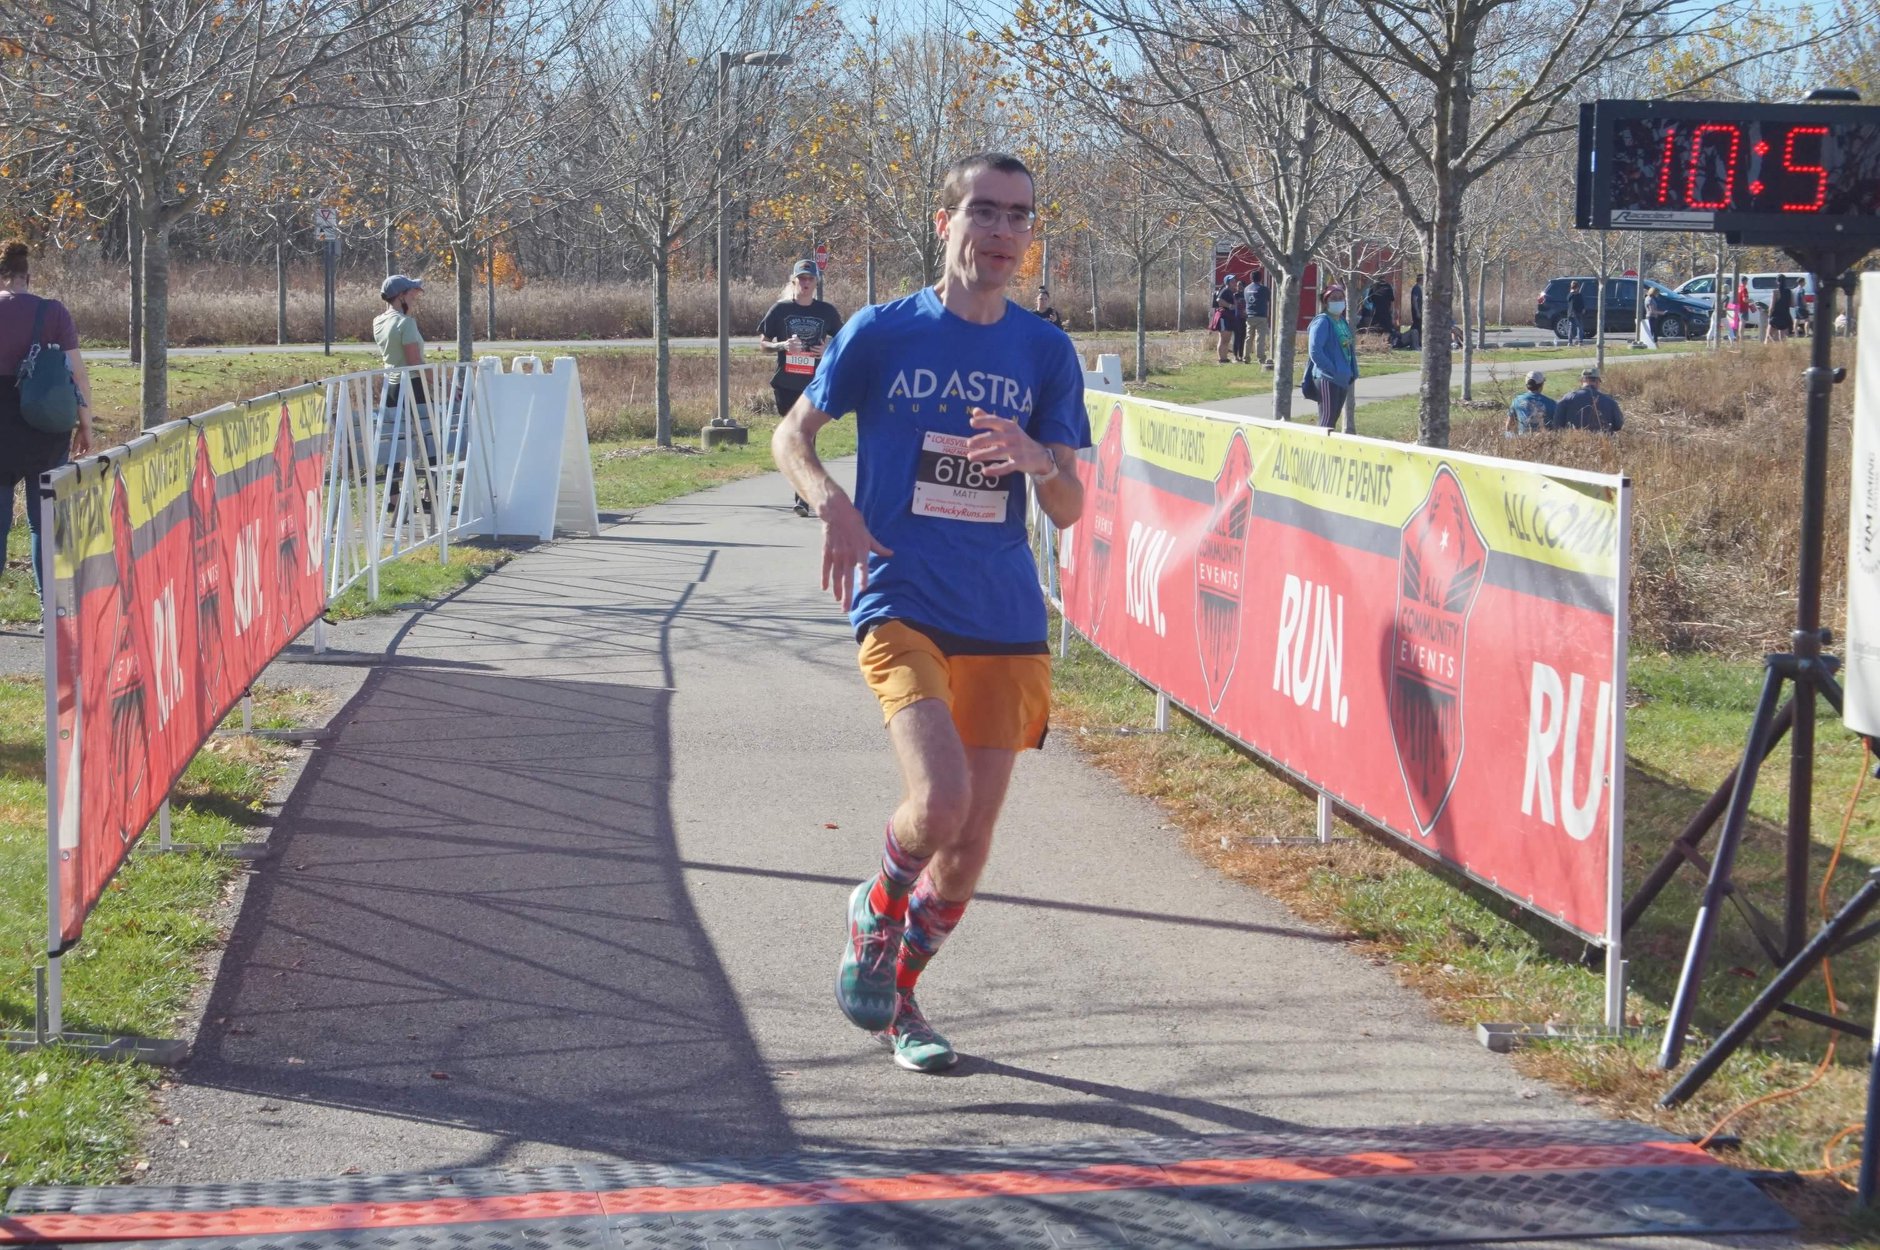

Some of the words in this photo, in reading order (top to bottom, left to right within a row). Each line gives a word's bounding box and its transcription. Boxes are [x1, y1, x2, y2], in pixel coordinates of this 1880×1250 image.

[887, 369, 937, 399] AD
[941, 369, 1033, 417] ASTRA
[1180, 428, 1205, 465] EVENTS
[952, 489, 978, 499] MATT
[1272, 442, 1289, 481] ALL
[1290, 446, 1346, 496] COMMUNITY
[1345, 459, 1393, 507] EVENTS
[924, 503, 996, 519] KentuckyRuns.com
[1504, 491, 1531, 542] ALL
[1126, 520, 1177, 638] RUN.
[1200, 563, 1239, 590] EVENTS
[1424, 575, 1441, 608] ALL
[1402, 606, 1460, 650] COMMUNITY
[1273, 573, 1349, 729] RUN.
[1401, 639, 1454, 679] EVENTS
[1521, 661, 1611, 841] RU
